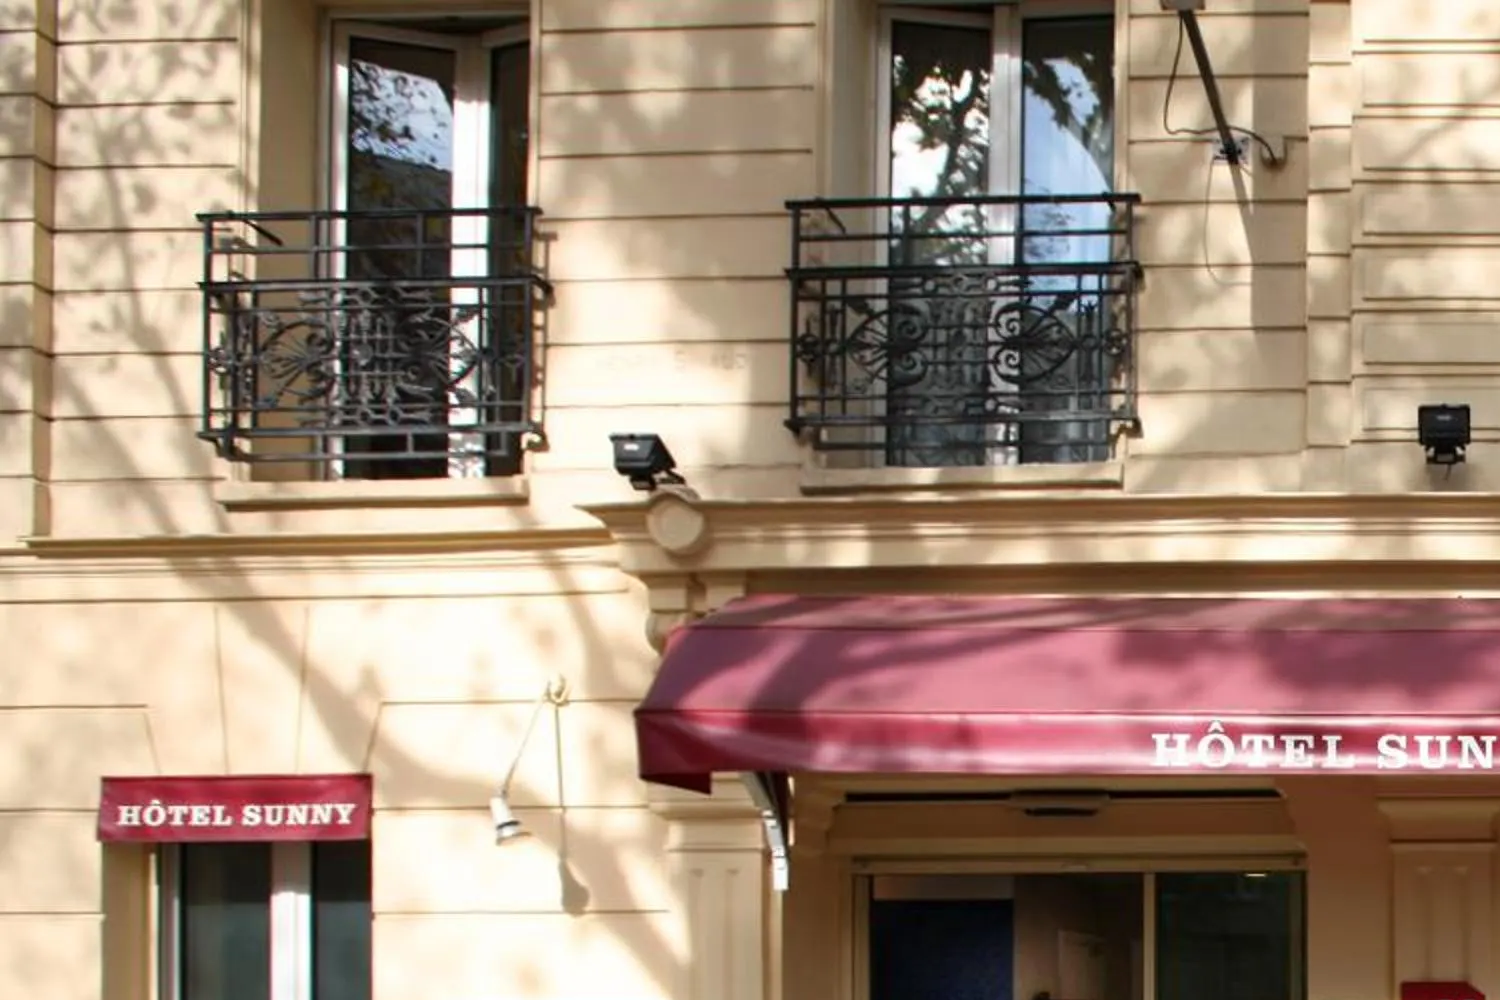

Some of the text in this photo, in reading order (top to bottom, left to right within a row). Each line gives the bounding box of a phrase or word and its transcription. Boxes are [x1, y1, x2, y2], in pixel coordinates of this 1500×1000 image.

[1151, 721, 1355, 768] HÔTEL
[117, 800, 357, 827] HÔTEL SUNNY
